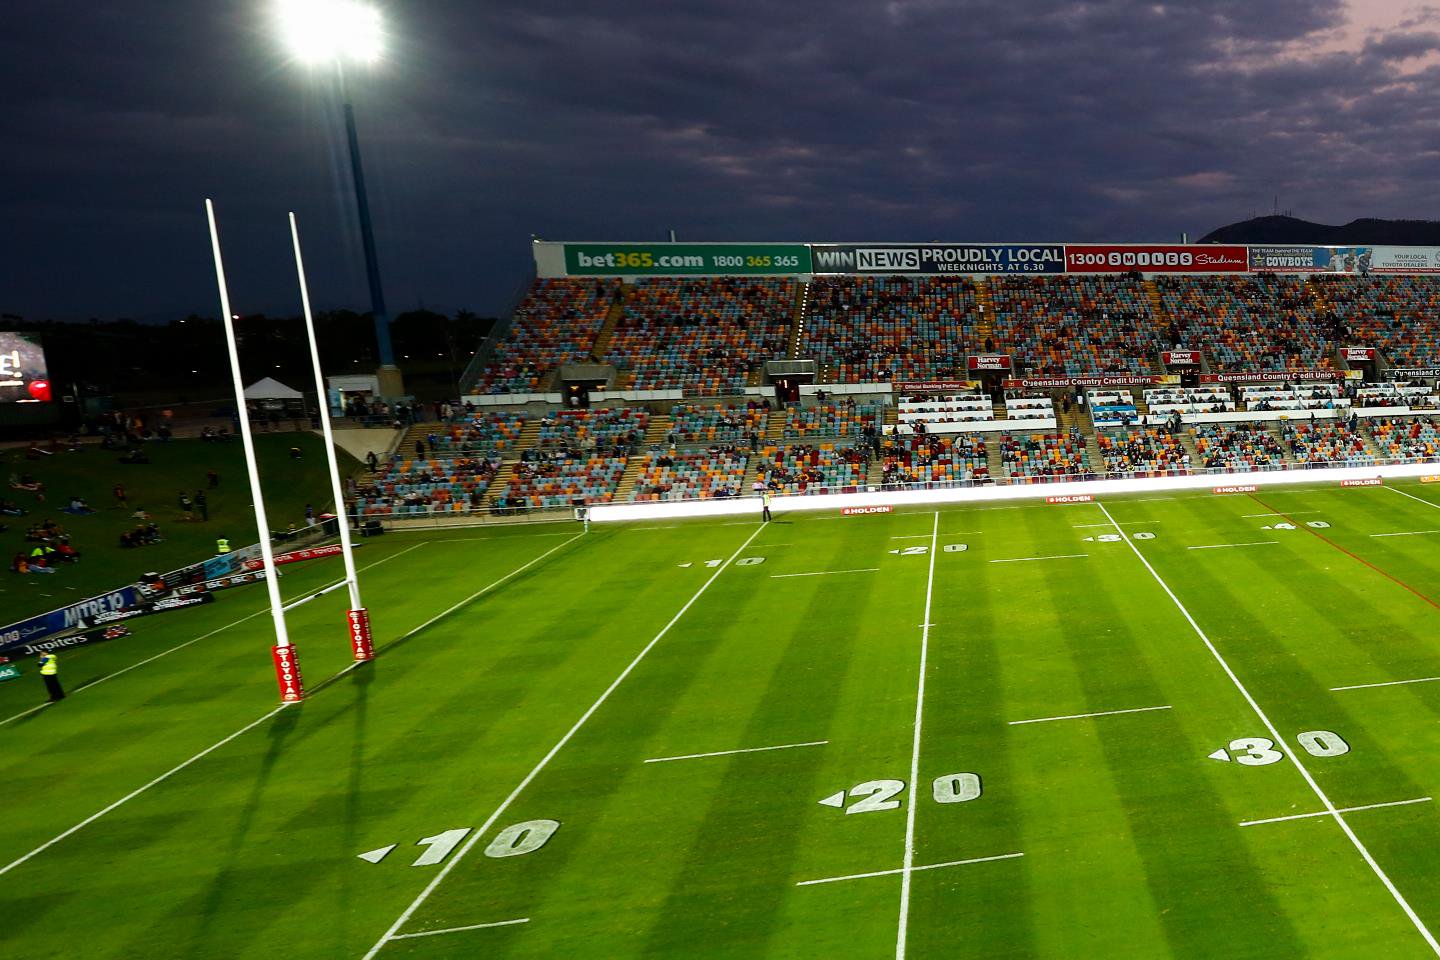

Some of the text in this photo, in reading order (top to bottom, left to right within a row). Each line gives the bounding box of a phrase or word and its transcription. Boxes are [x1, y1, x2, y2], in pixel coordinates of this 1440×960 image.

[578, 252, 799, 268] bet365.com 1800 365 365
[817, 251, 918, 268] WIN NEWS
[922, 249, 1062, 263] PROUDLY LOCAL
[1069, 252, 1244, 266] 1300 SMILES Stadium
[1266, 256, 1314, 267] COWBOYS
[937, 263, 1045, 271] WEEKNIGHTS AT 6.30
[977, 356, 1000, 364] Harvey
[1022, 376, 1151, 387] Queensland Country Credit Union
[1218, 373, 1262, 382] Queensland
[1263, 373, 1290, 381] Country
[313, 546, 342, 555] TOYOTA
[63, 592, 124, 628] MITRE 10
[352, 617, 365, 653] TOYOTA
[25, 634, 88, 655] Jupiters
[280, 654, 295, 694] TOYOTA
